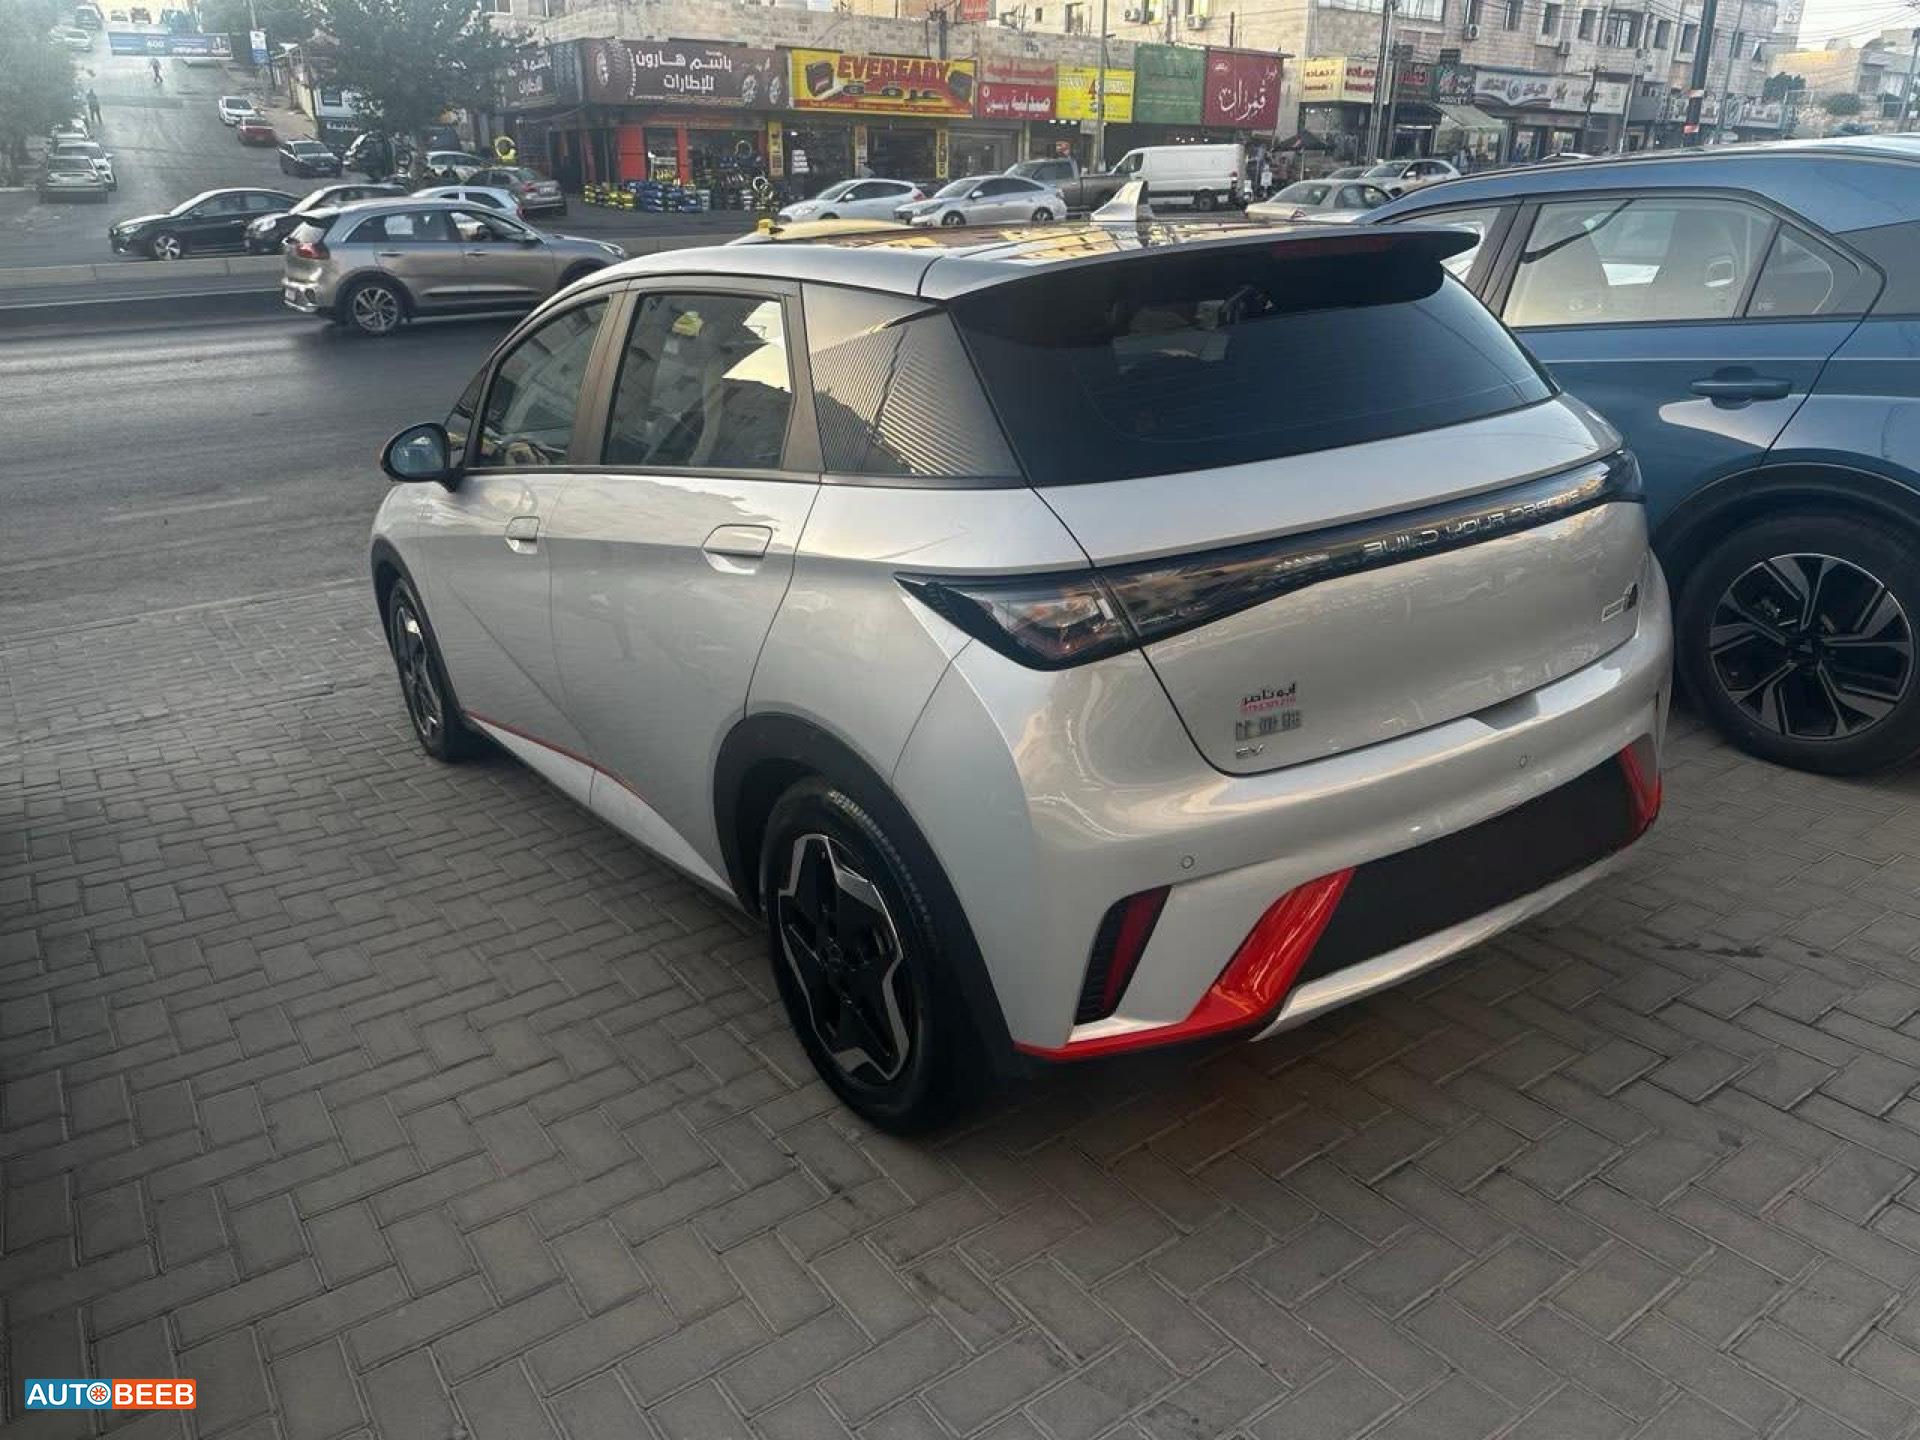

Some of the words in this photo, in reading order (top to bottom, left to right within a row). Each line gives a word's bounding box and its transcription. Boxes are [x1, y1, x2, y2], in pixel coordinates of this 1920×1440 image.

[635, 50, 687, 68] هارون
[837, 54, 955, 84] EVEREADY
[1445, 512, 1506, 539] YOUR
